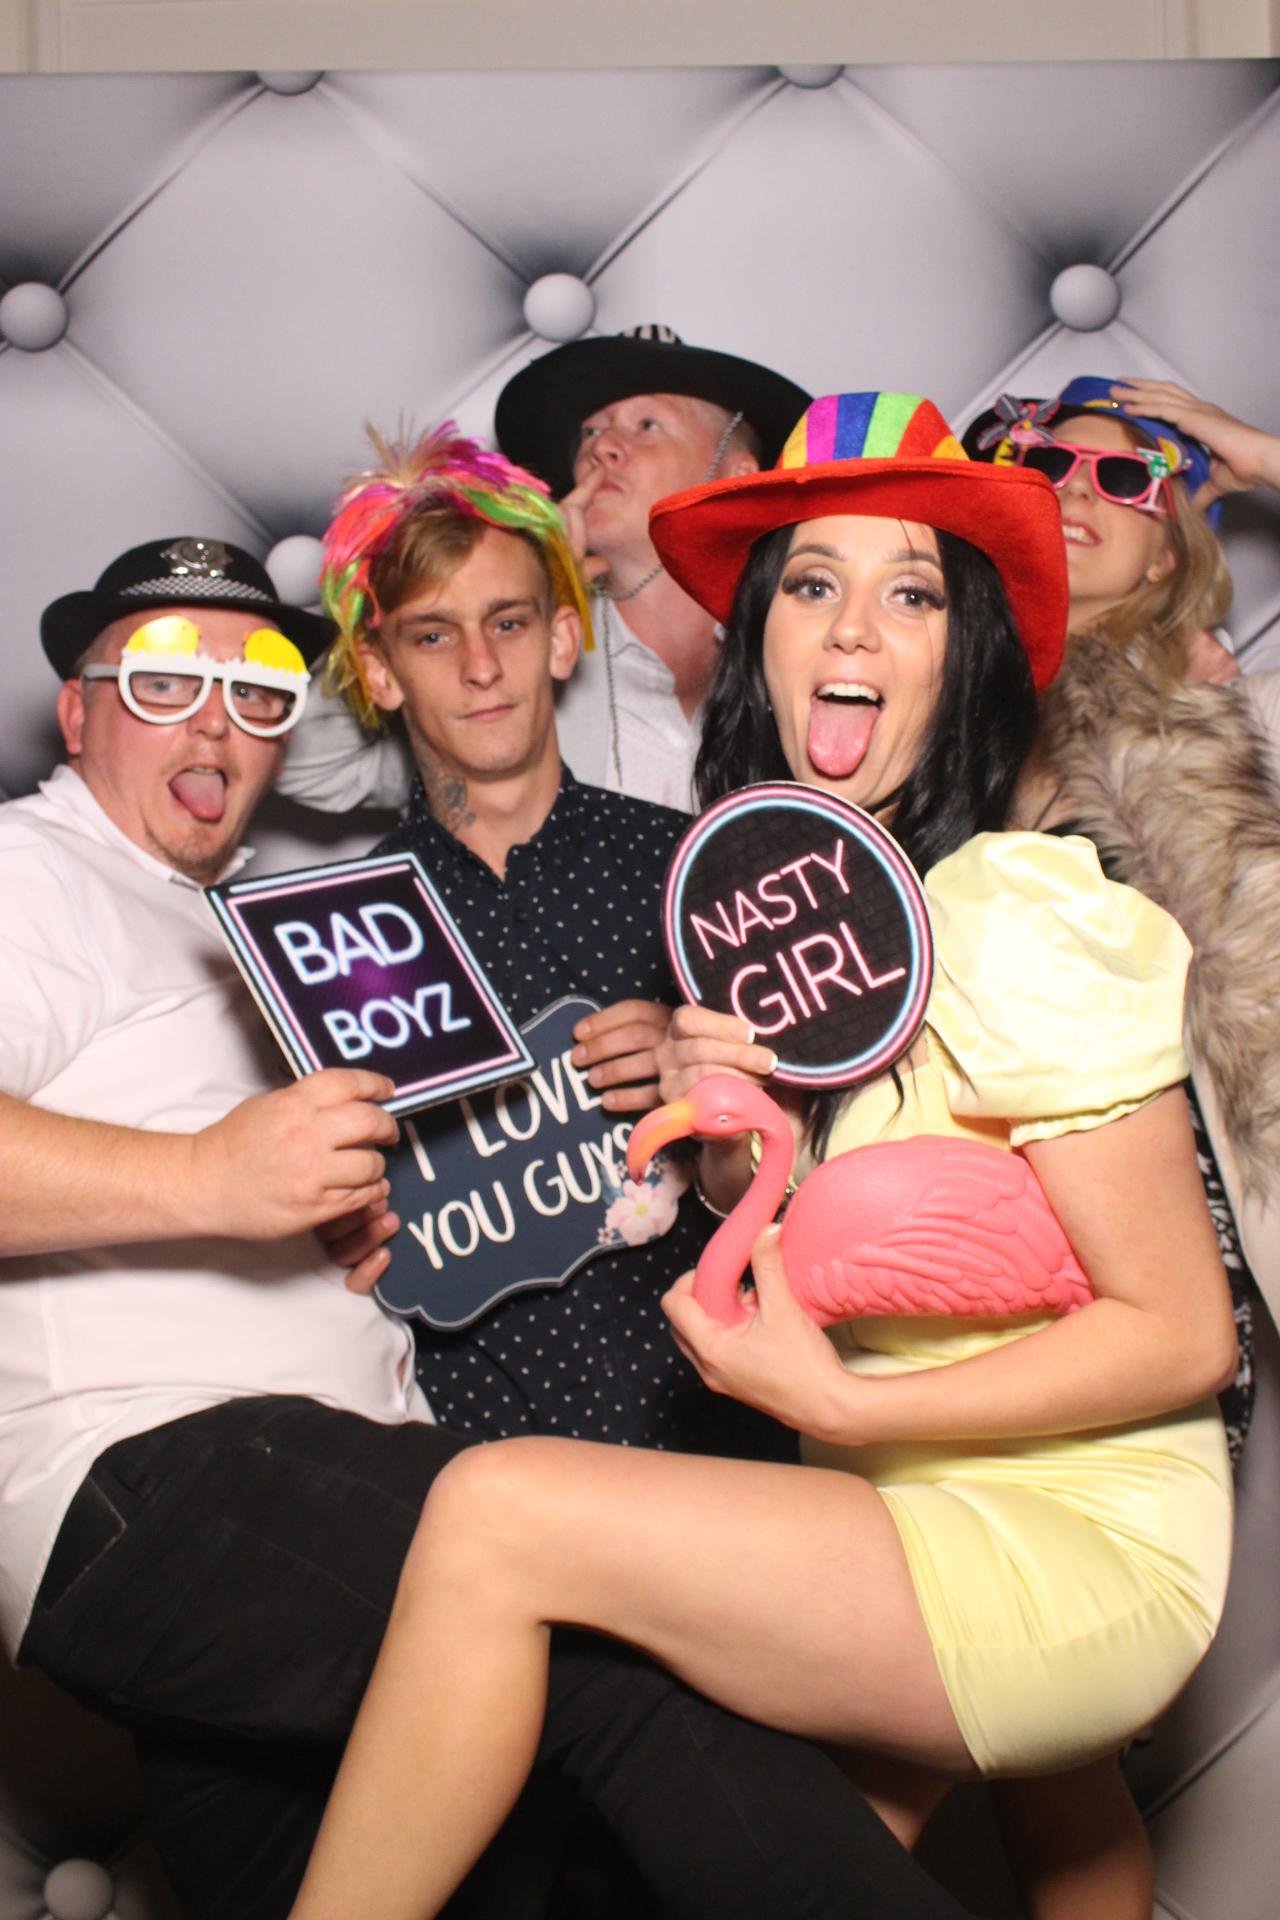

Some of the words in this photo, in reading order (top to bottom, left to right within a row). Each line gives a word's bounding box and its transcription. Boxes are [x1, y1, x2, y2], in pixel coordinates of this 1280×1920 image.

[273, 903, 425, 986] BAD
[690, 839, 850, 960] NASTY
[322, 982, 472, 1061] BOYZ
[731, 921, 906, 1035] GIRL
[403, 1118, 437, 1182] I
[458, 1049, 603, 1158] LOVE
[407, 1180, 516, 1270] YOU
